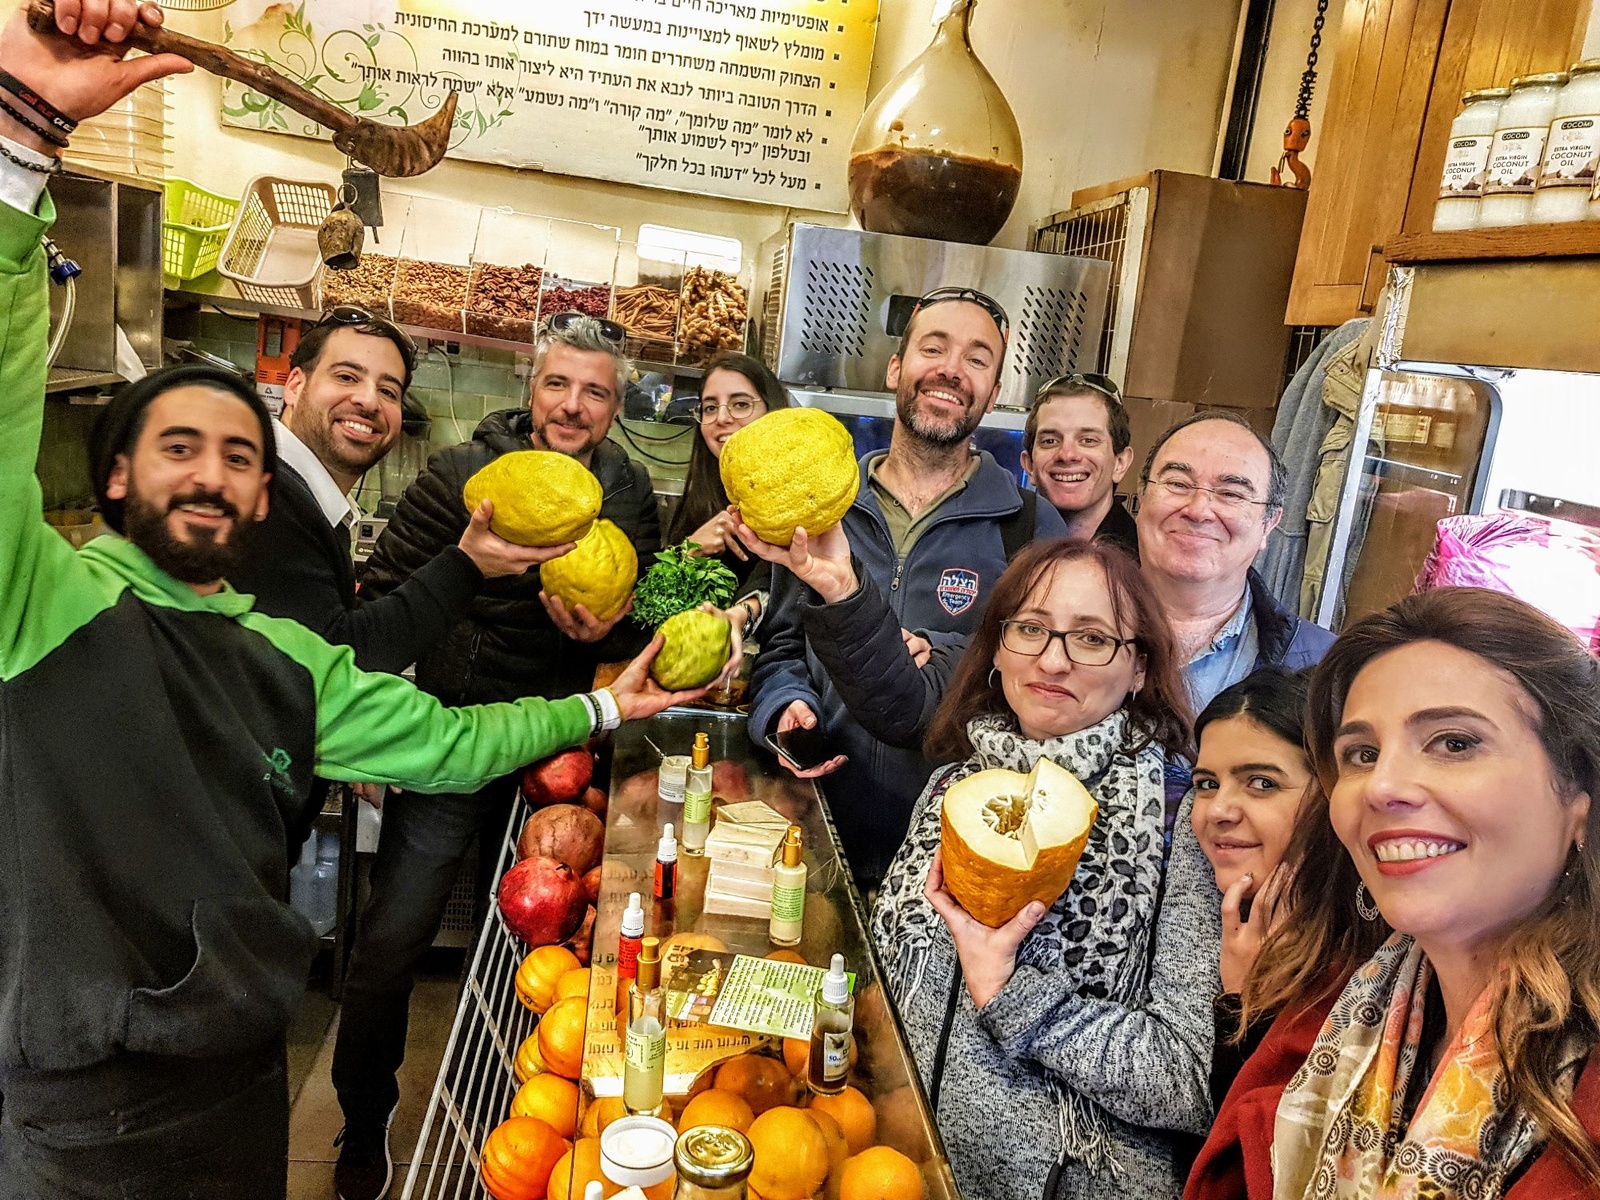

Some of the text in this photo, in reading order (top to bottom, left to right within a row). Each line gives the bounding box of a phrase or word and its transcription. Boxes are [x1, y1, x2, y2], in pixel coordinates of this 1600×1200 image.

[705, 1, 756, 19] מאריכה
[761, 10, 829, 32] אופטימיות
[583, 11, 824, 60] מומלץ לשאוף למצויינות במעשה ידך
[394, 11, 820, 89] הצחוק והשמחה משחררים חומר במוח שתורם למערכת החיסונית
[396, 69, 438, 86] לראות
[443, 48, 816, 118] הדרך הטובה ביותר לנבא את העתיד היא ליצור אותו בהווה
[487, 82, 513, 99] אלא
[763, 125, 792, 140] לומר
[796, 128, 813, 143] לא
[681, 133, 726, 150] לשמוע
[763, 144, 810, 163] ובטלפון
[1550, 151, 1593, 160] COCONUT
[682, 157, 705, 176] בכל
[753, 168, 775, 185] לכל
[780, 172, 806, 190] מעל
[943, 575, 976, 589] הצלה
